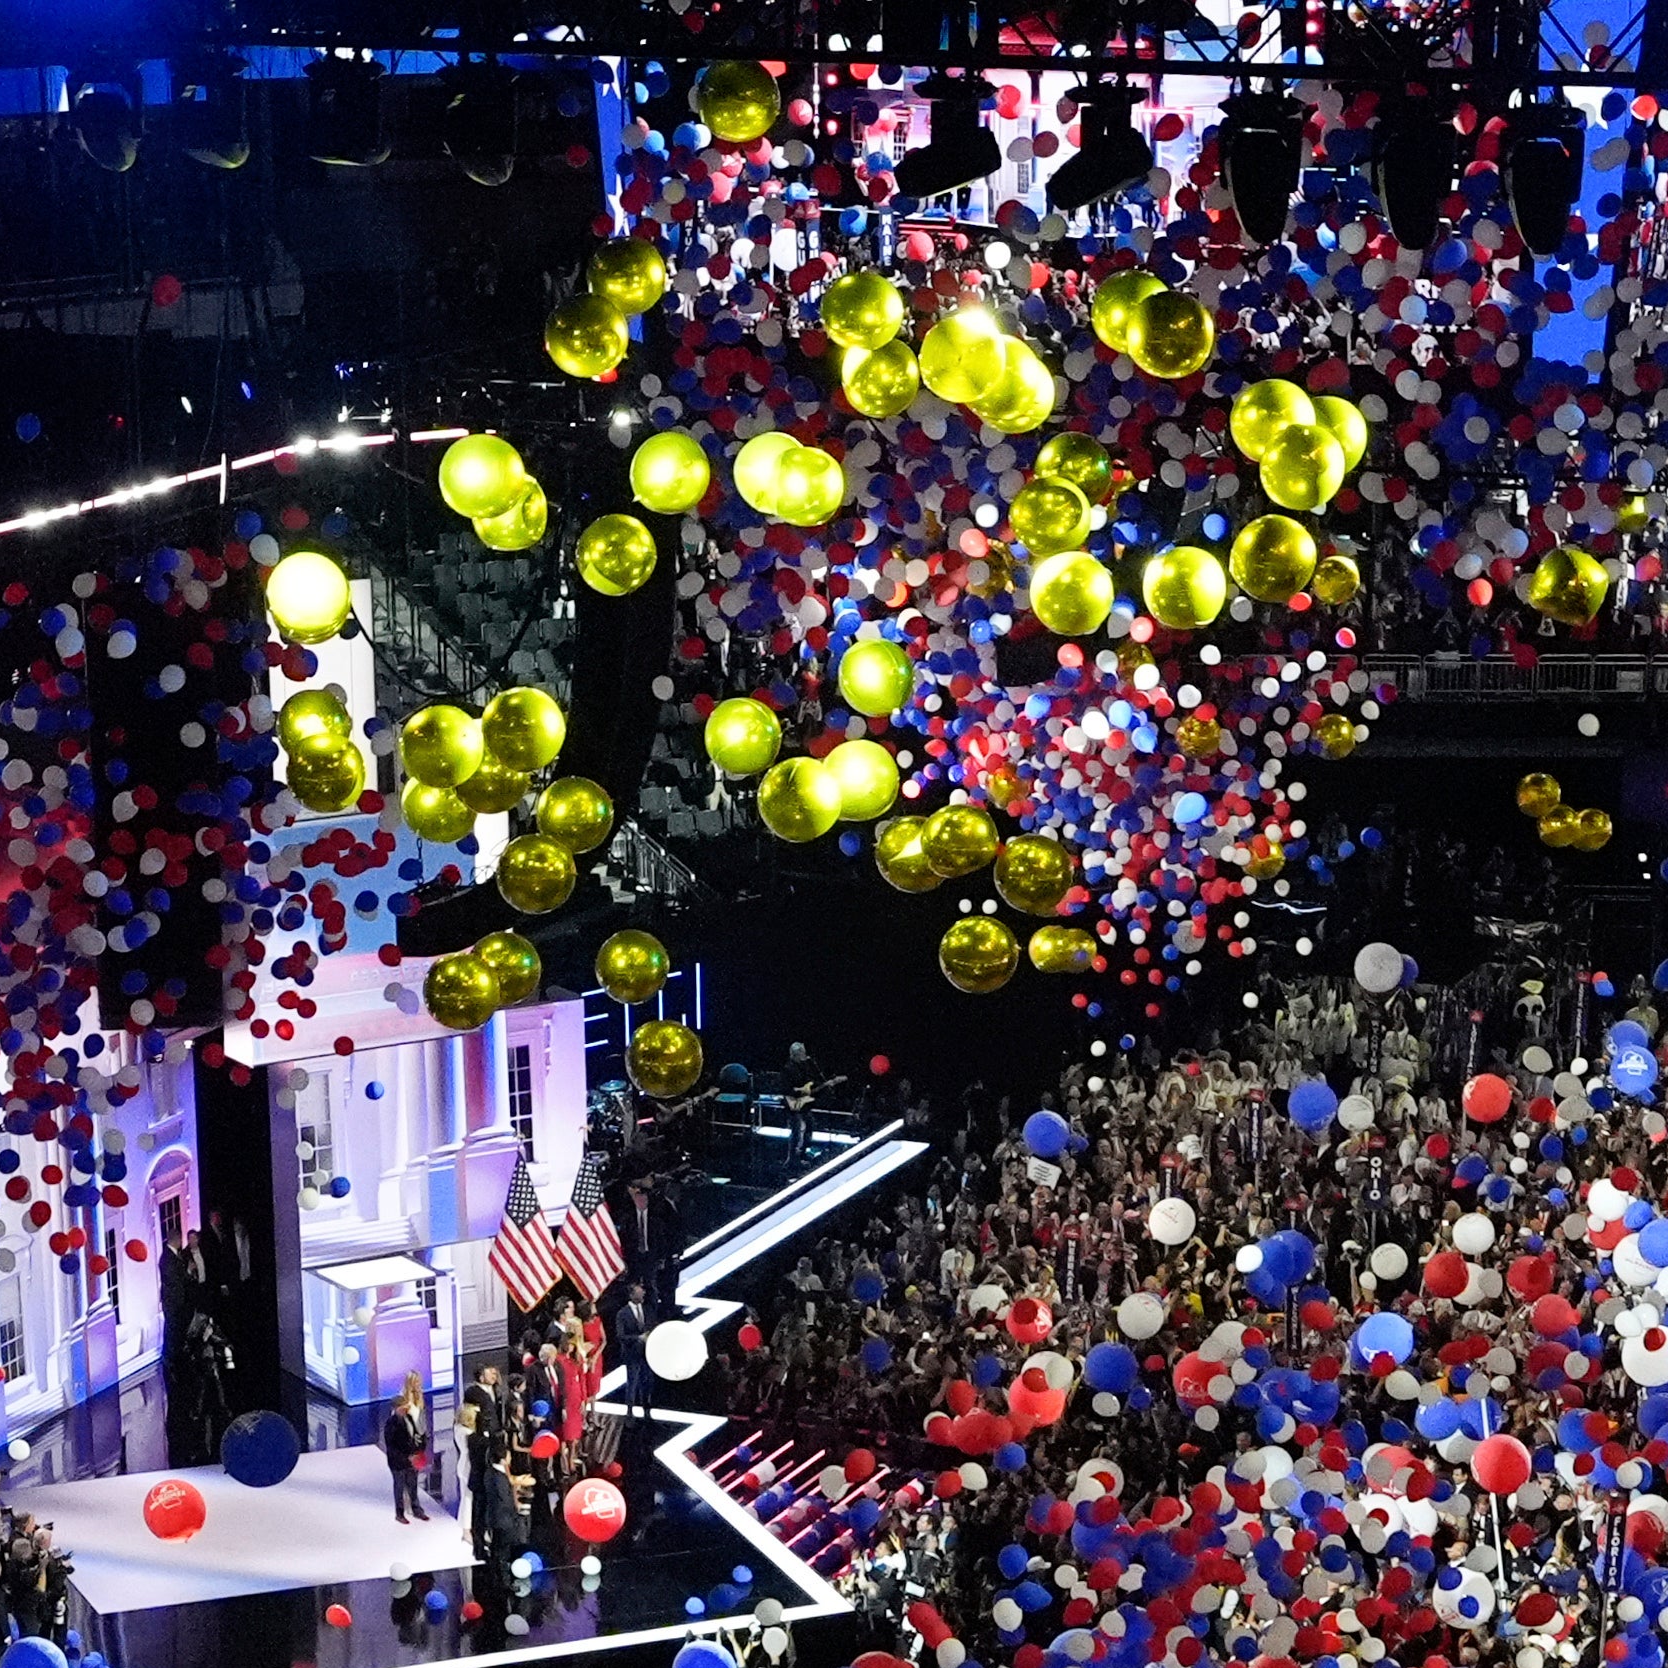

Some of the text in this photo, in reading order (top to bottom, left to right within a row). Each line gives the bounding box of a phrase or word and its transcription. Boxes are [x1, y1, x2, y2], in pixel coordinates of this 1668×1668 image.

[1370, 1156, 1383, 1200] OHIO
[1065, 1239, 1076, 1300] NEBRASKA
[1609, 1516, 1621, 1587] FLORIDA
